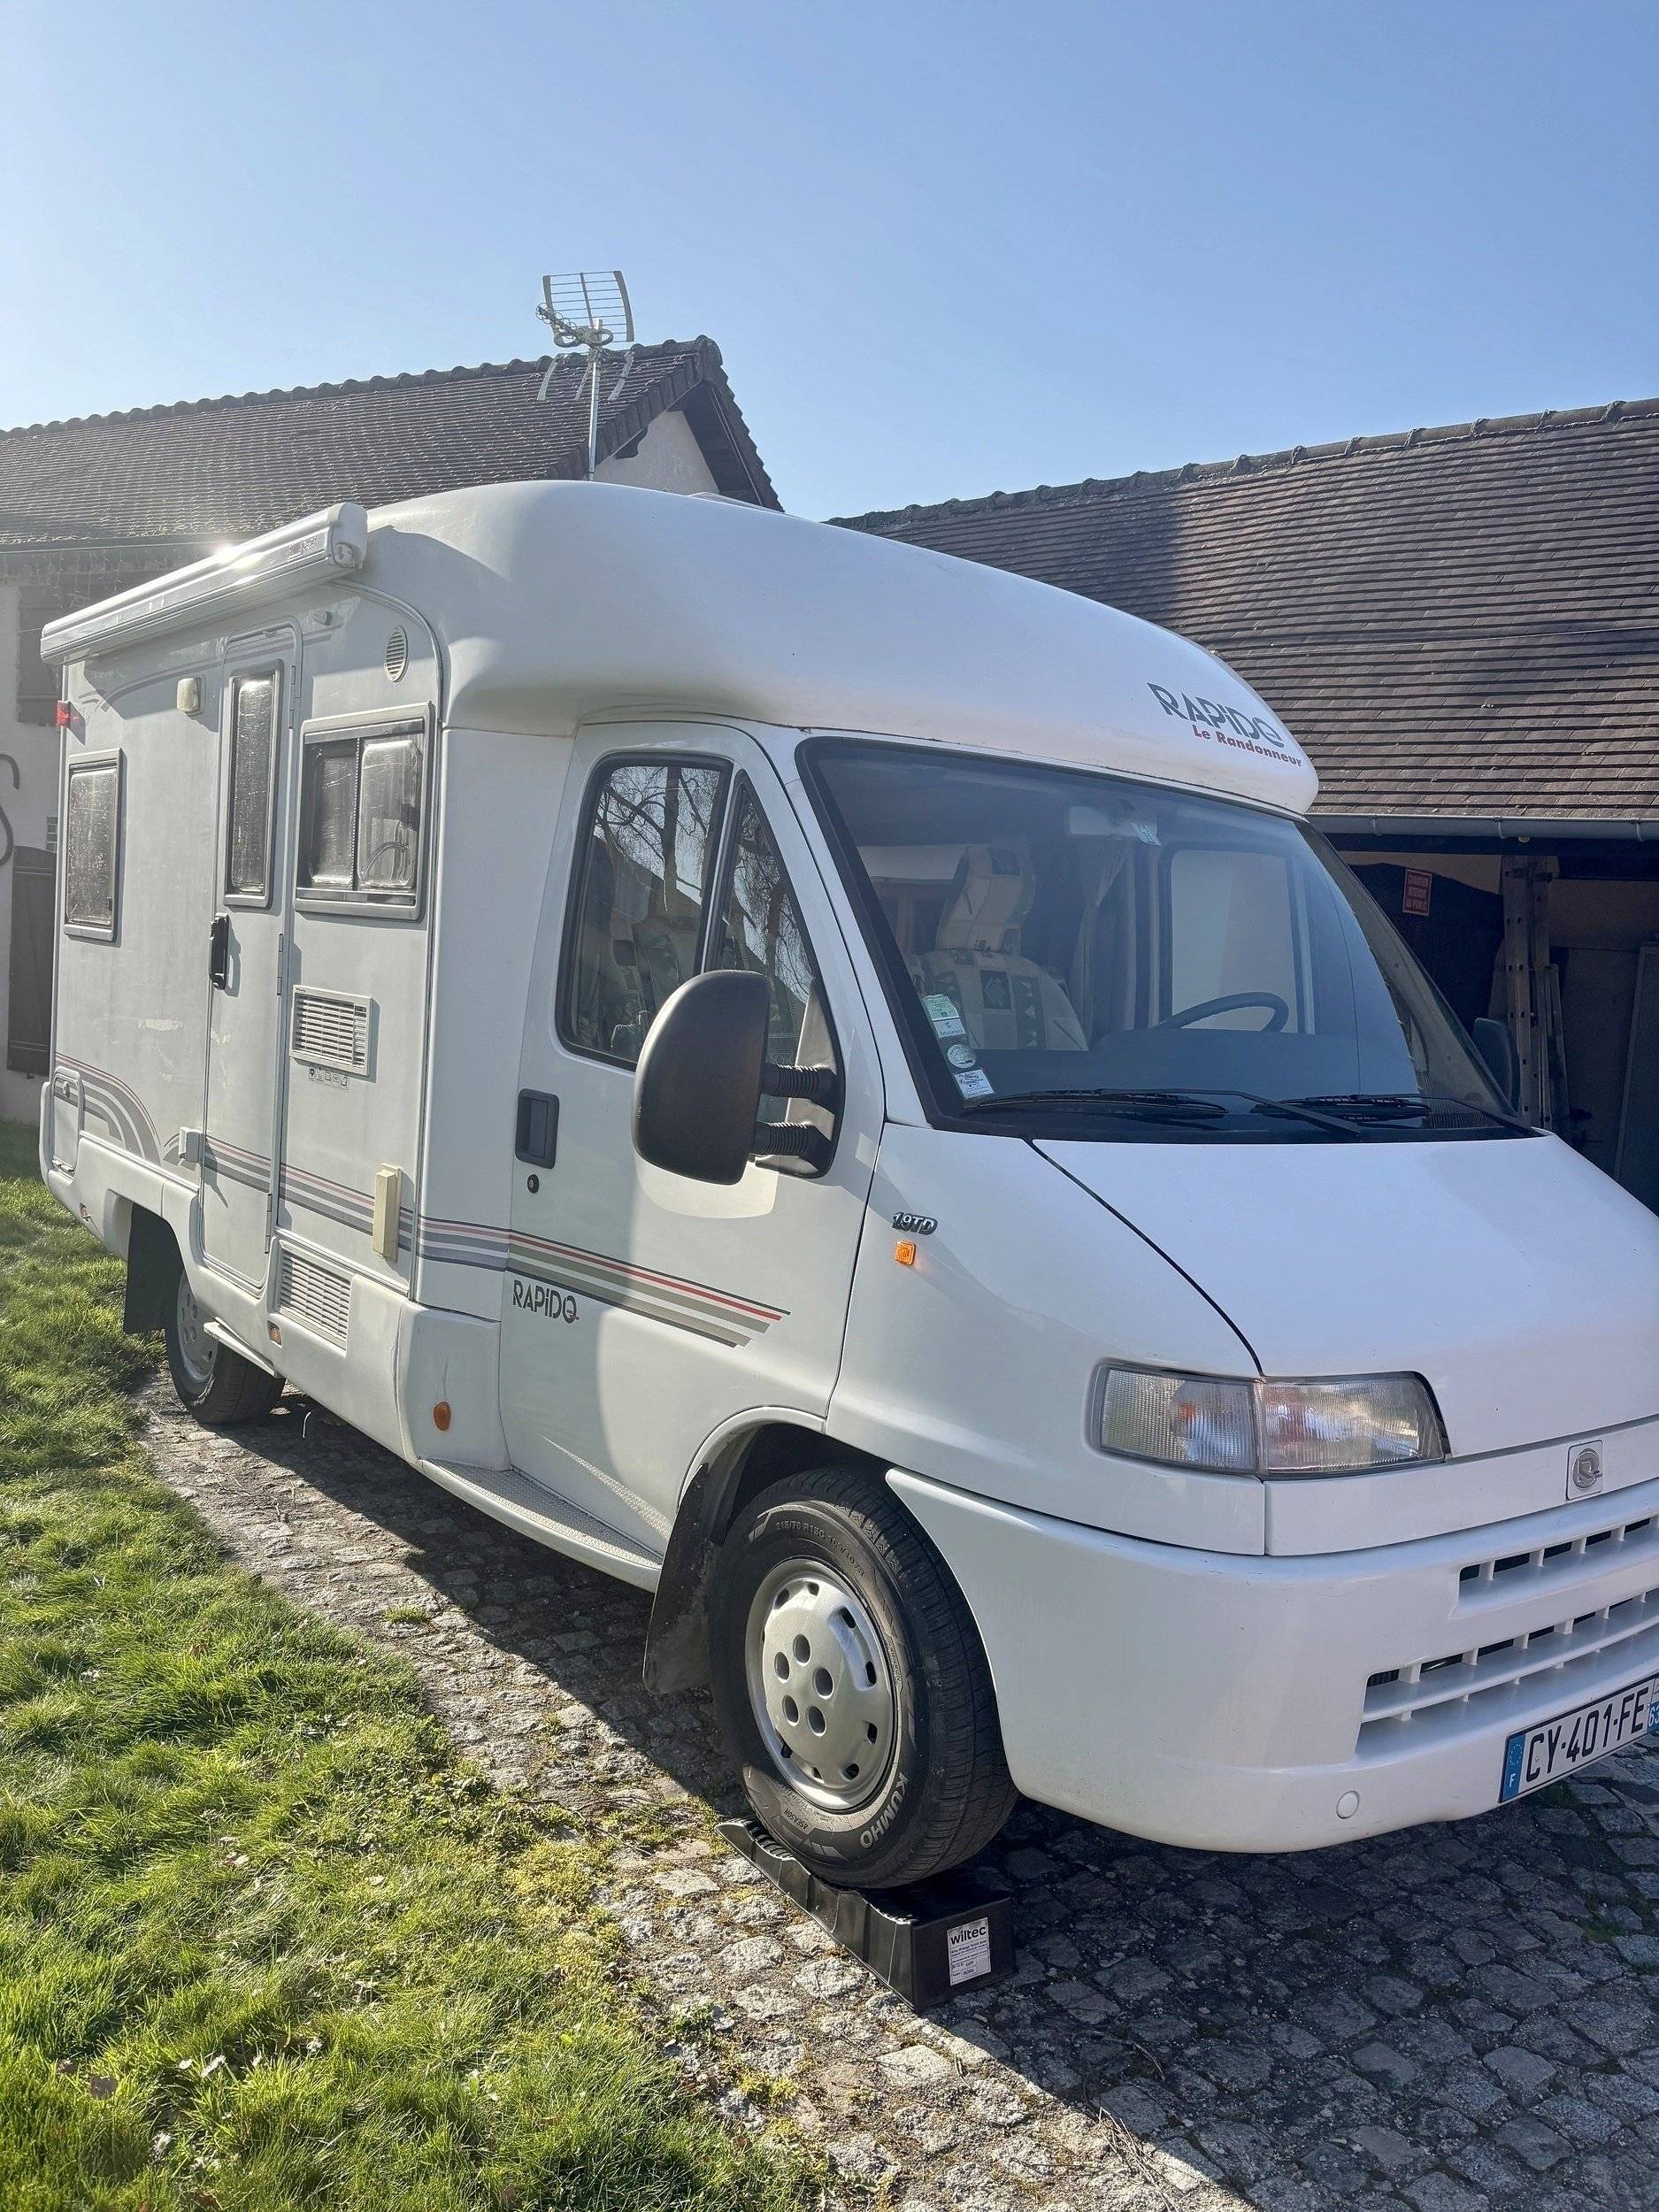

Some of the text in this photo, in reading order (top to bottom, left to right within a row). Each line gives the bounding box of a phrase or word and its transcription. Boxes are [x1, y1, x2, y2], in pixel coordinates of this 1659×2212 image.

[1192, 724, 1302, 767] Le Randonneur
[1509, 1773, 1517, 1788] F
[860, 1771, 910, 1848] KUMHO
[950, 1926, 987, 1946] wiltec
